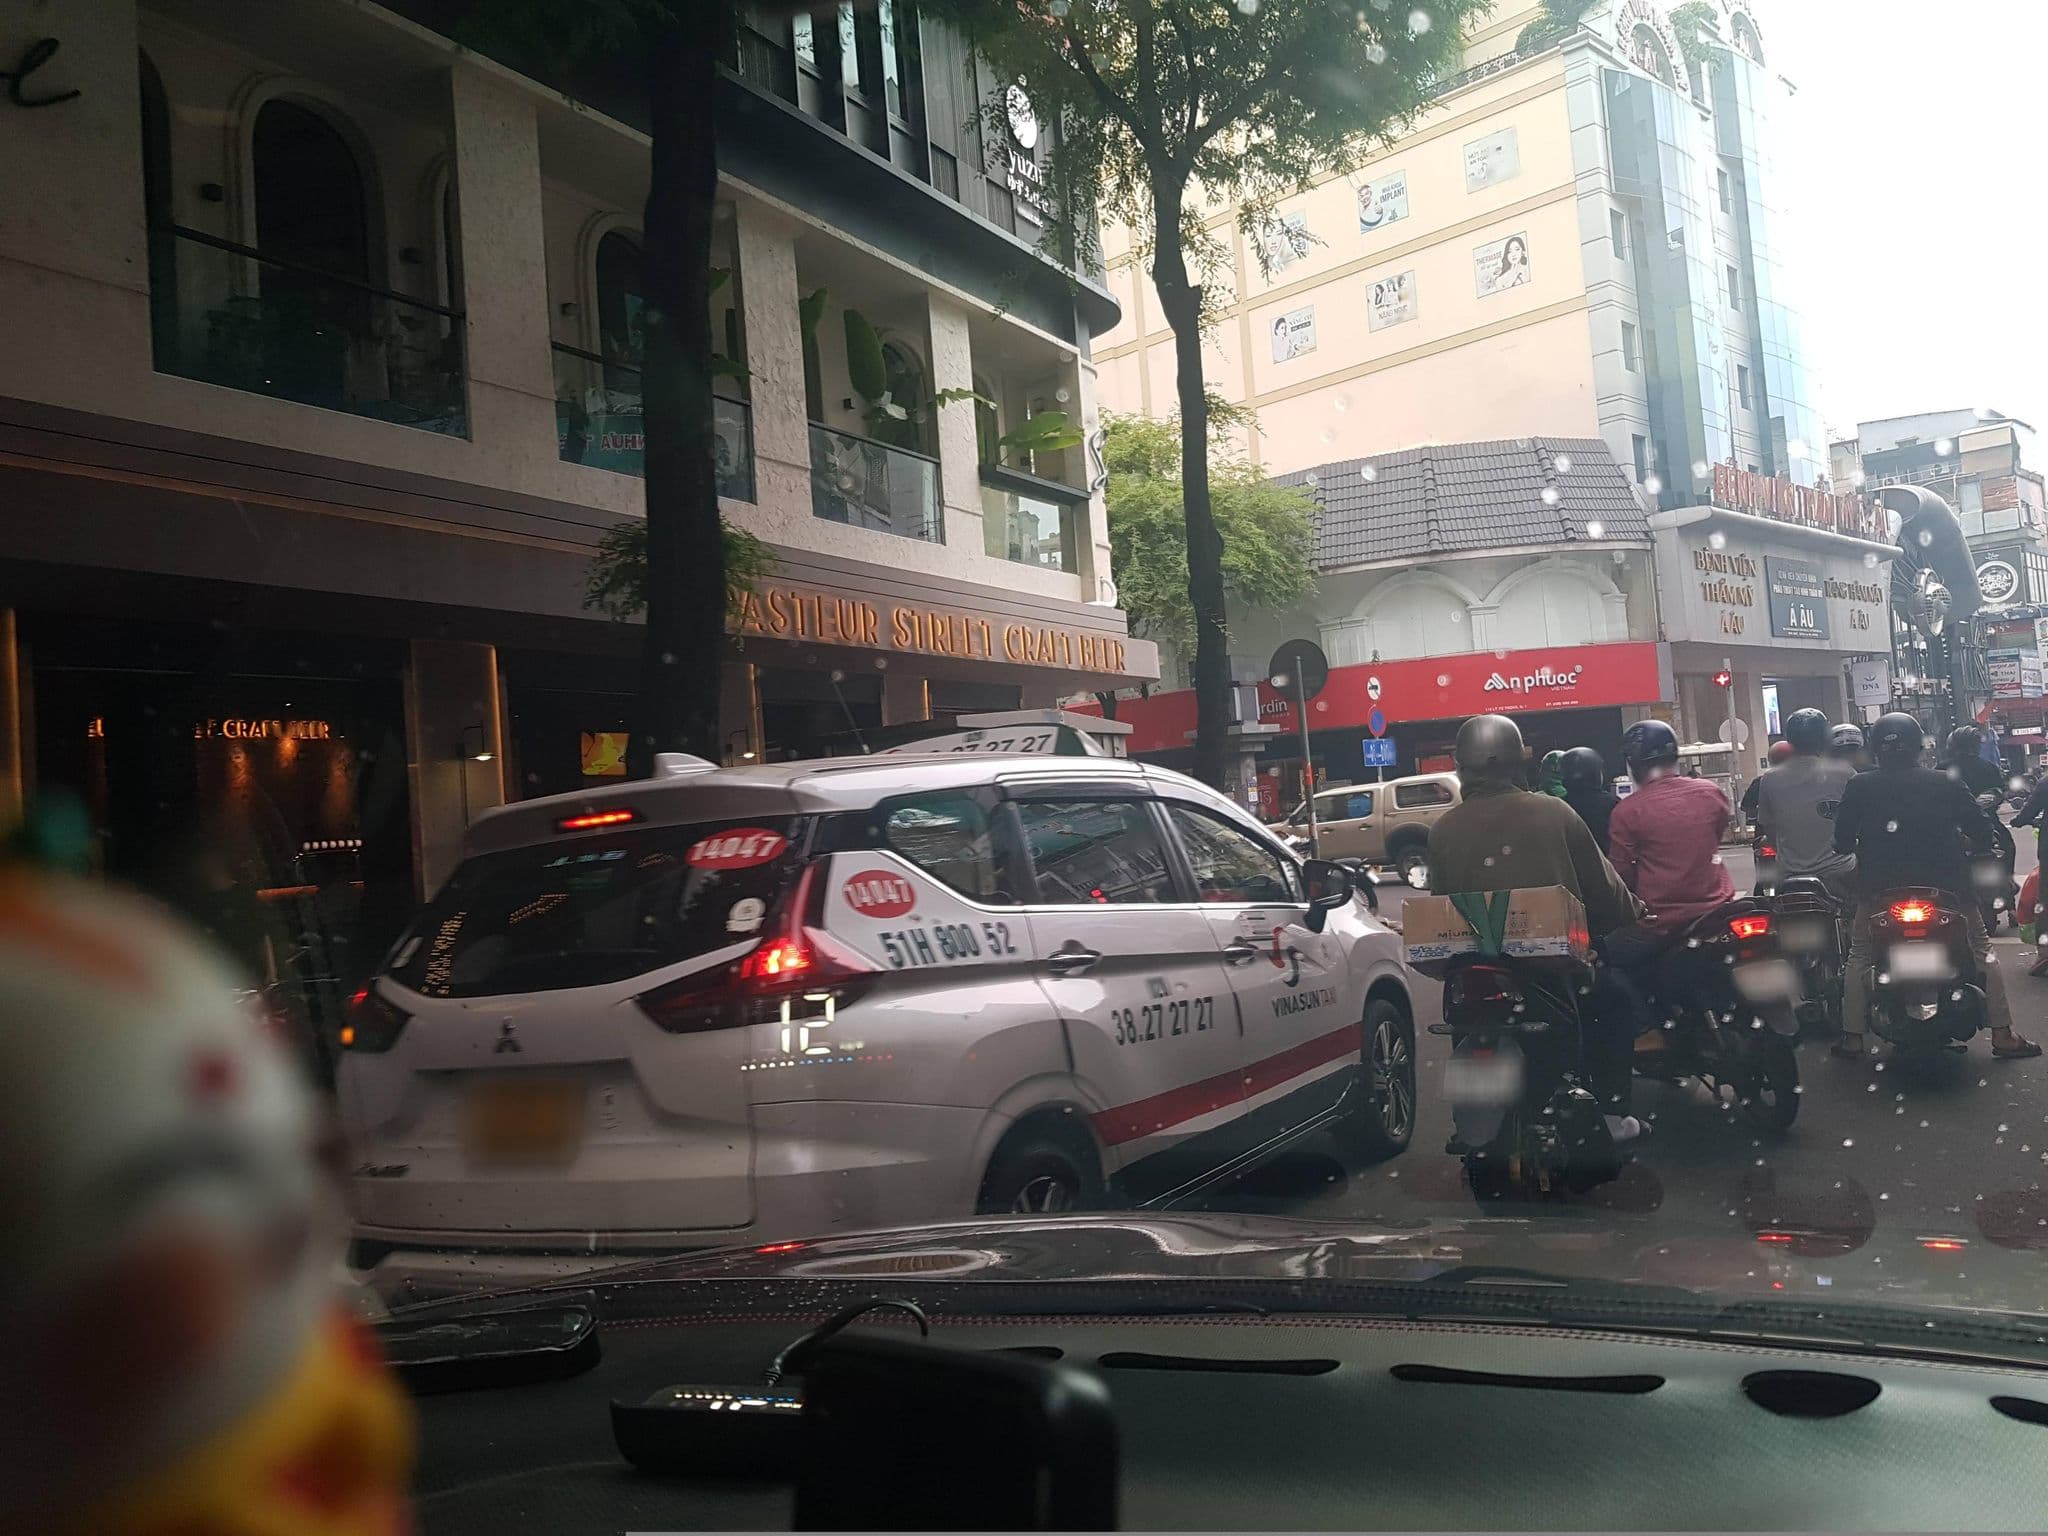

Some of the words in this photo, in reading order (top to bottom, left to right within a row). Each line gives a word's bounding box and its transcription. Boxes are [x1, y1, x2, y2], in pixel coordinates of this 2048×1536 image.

[728, 588, 879, 645] ASTEUR
[893, 609, 993, 657] STREET
[1004, 624, 1073, 666] CRAFT
[1078, 634, 1127, 672] BEER
[1790, 602, 1798, 627] Á
[1800, 603, 1814, 628] ÂU
[1259, 699, 1288, 715] rdin
[1021, 733, 1053, 753] 27
[877, 928, 938, 968] 51H
[933, 923, 981, 960] 800
[979, 921, 1016, 955] 52
[780, 993, 835, 1056] 12
[1111, 1003, 1163, 1046] 38.27
[1169, 999, 1189, 1037] 27
[1194, 996, 1215, 1031] 27
